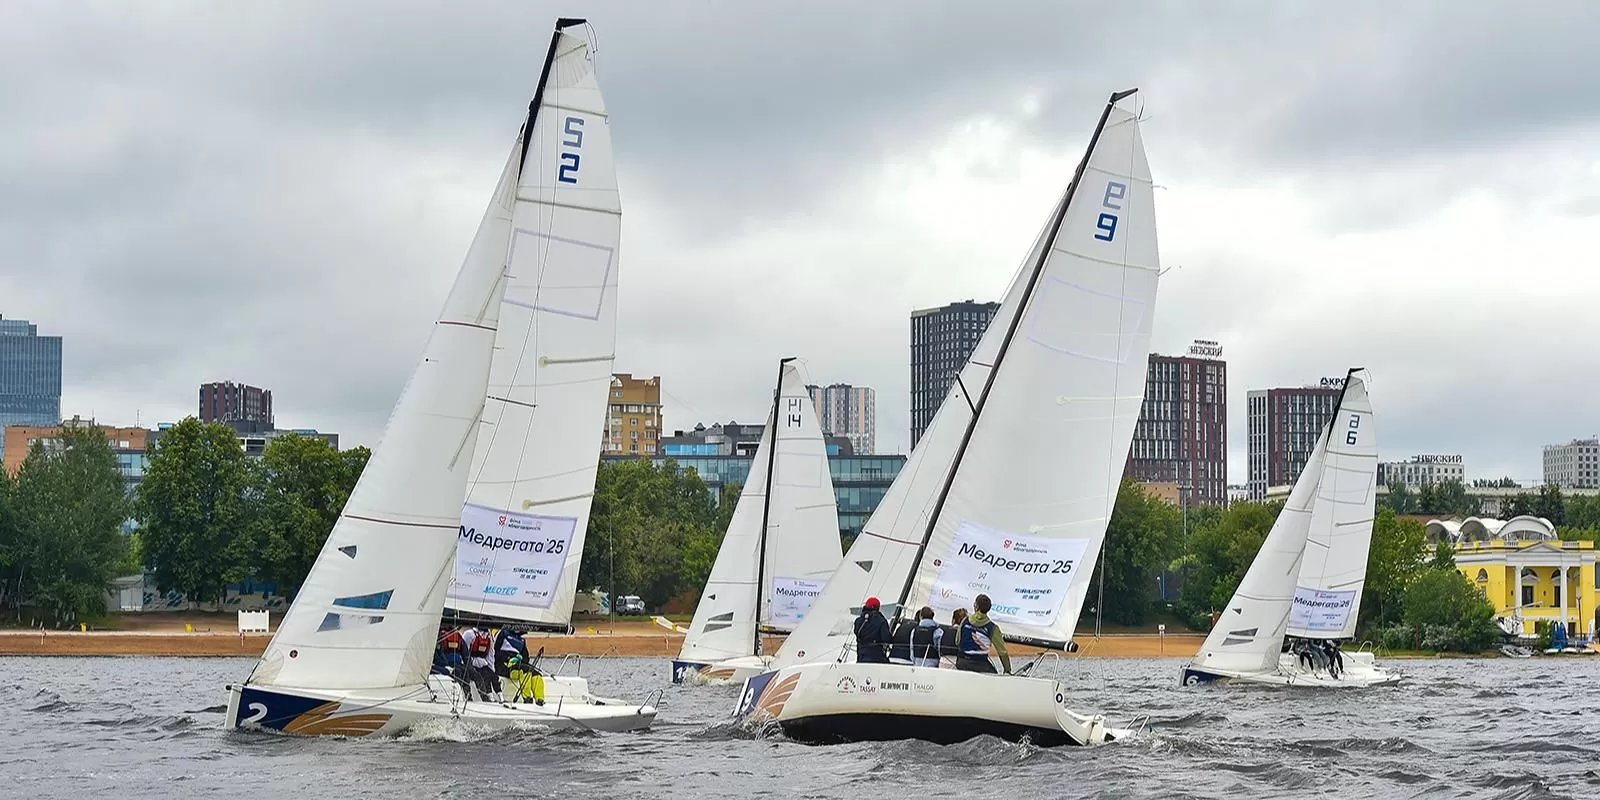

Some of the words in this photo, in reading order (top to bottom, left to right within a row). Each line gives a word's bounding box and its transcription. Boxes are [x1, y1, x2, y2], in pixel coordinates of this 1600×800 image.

[558, 152, 580, 184] 2
[1094, 212, 1118, 242] 9
[788, 414, 801, 427] 14
[1346, 431, 1357, 445] 6
[458, 525, 545, 553] Медрегата
[958, 542, 1049, 574] Медрегата
[992, 603, 1020, 615] EDTEC
[1187, 675, 1199, 686] 6
[741, 688, 754, 712] 9
[240, 702, 268, 727] 2
